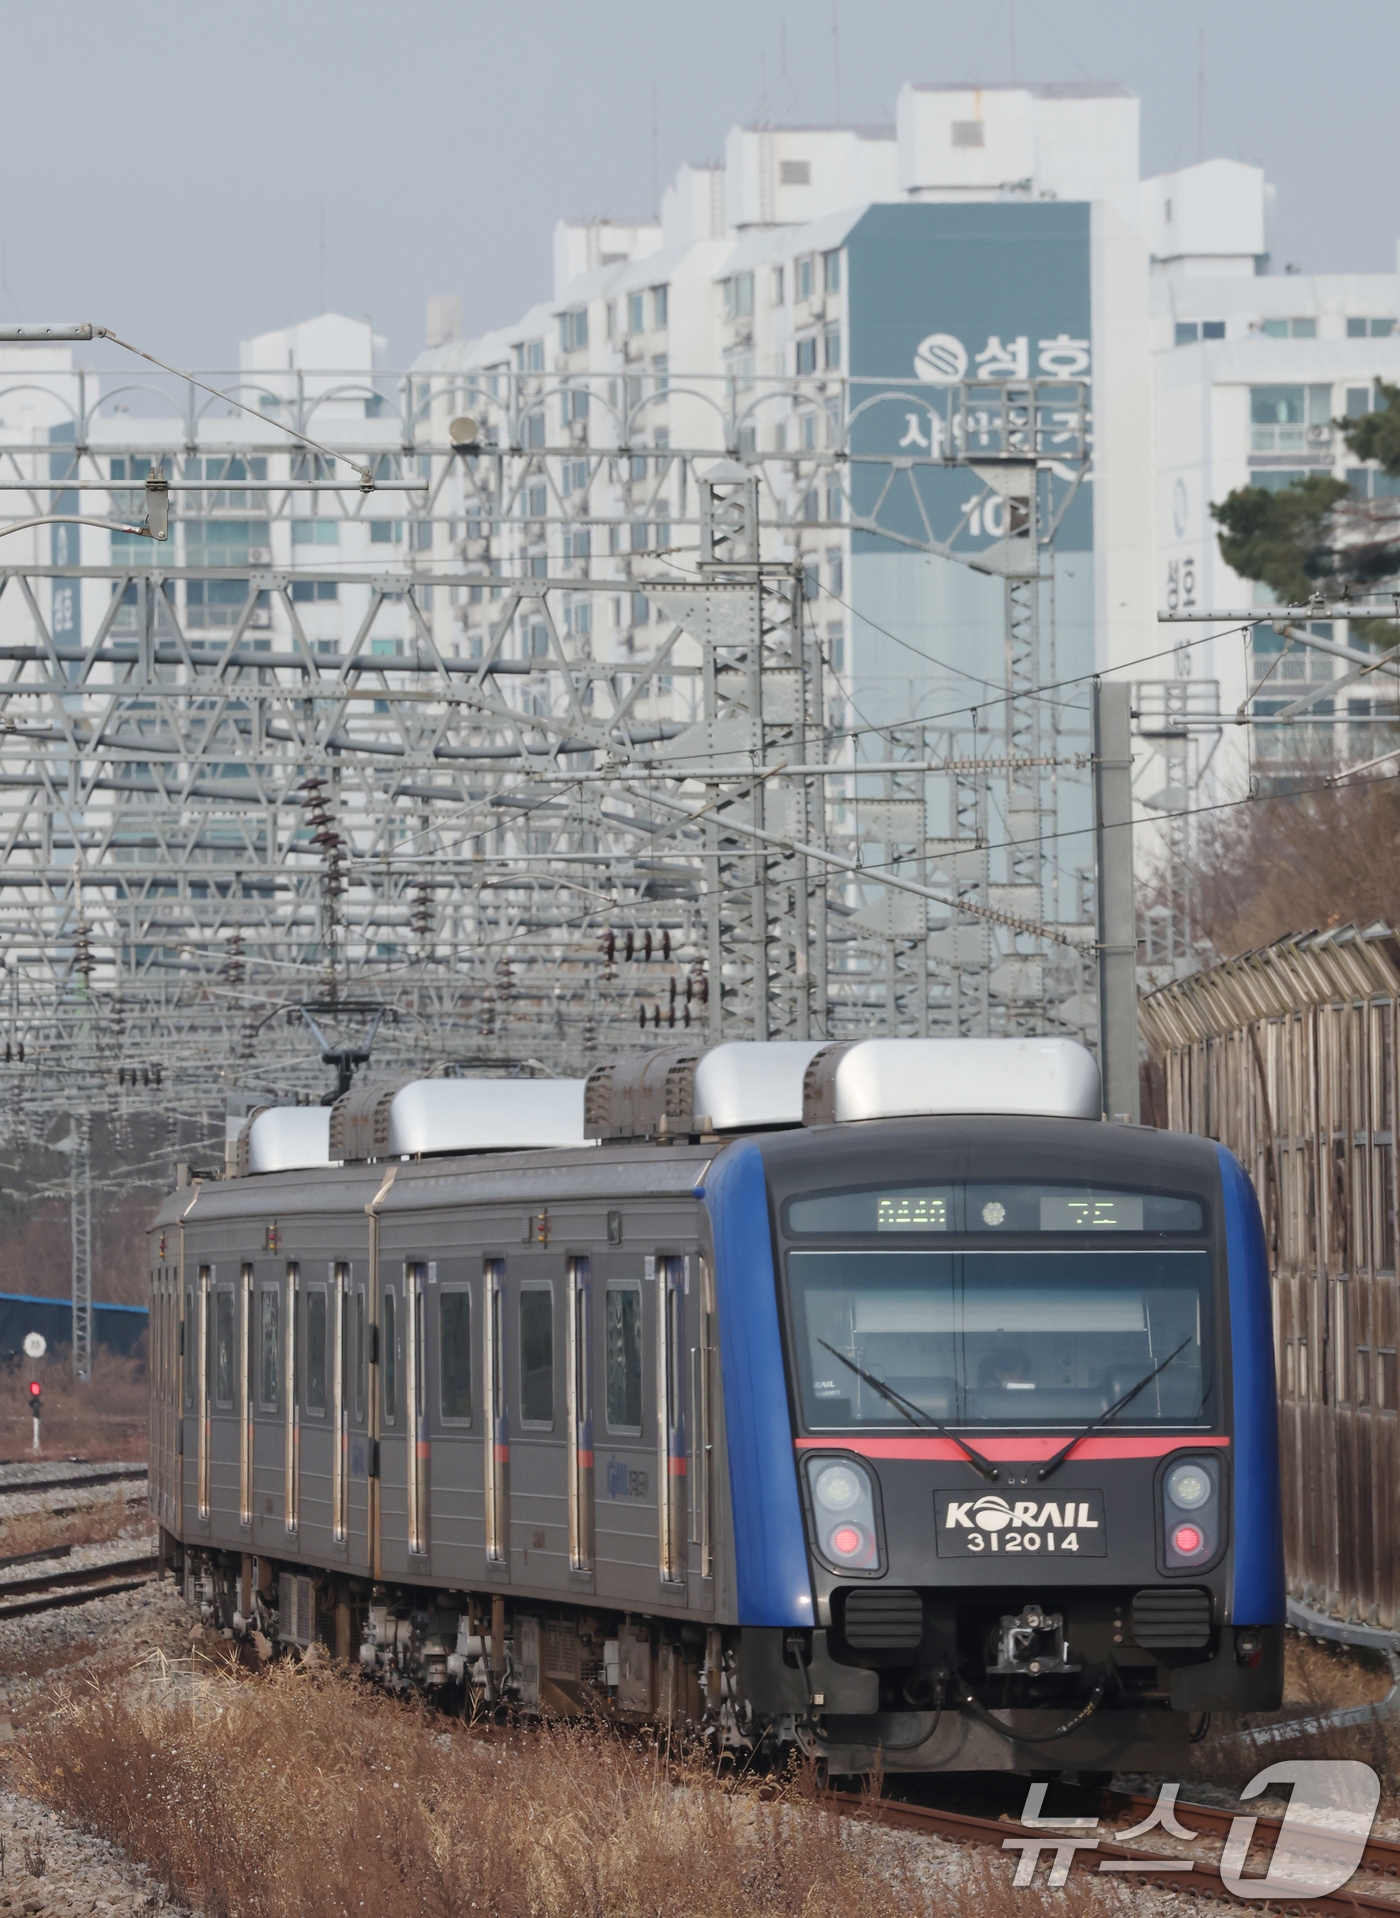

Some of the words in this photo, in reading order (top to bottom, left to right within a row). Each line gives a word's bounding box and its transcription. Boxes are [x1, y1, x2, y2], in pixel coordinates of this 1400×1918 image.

[974, 333, 1091, 385] 성호
[945, 1495, 1099, 1531] KORAIL
[967, 1532, 1079, 1551] 312014
